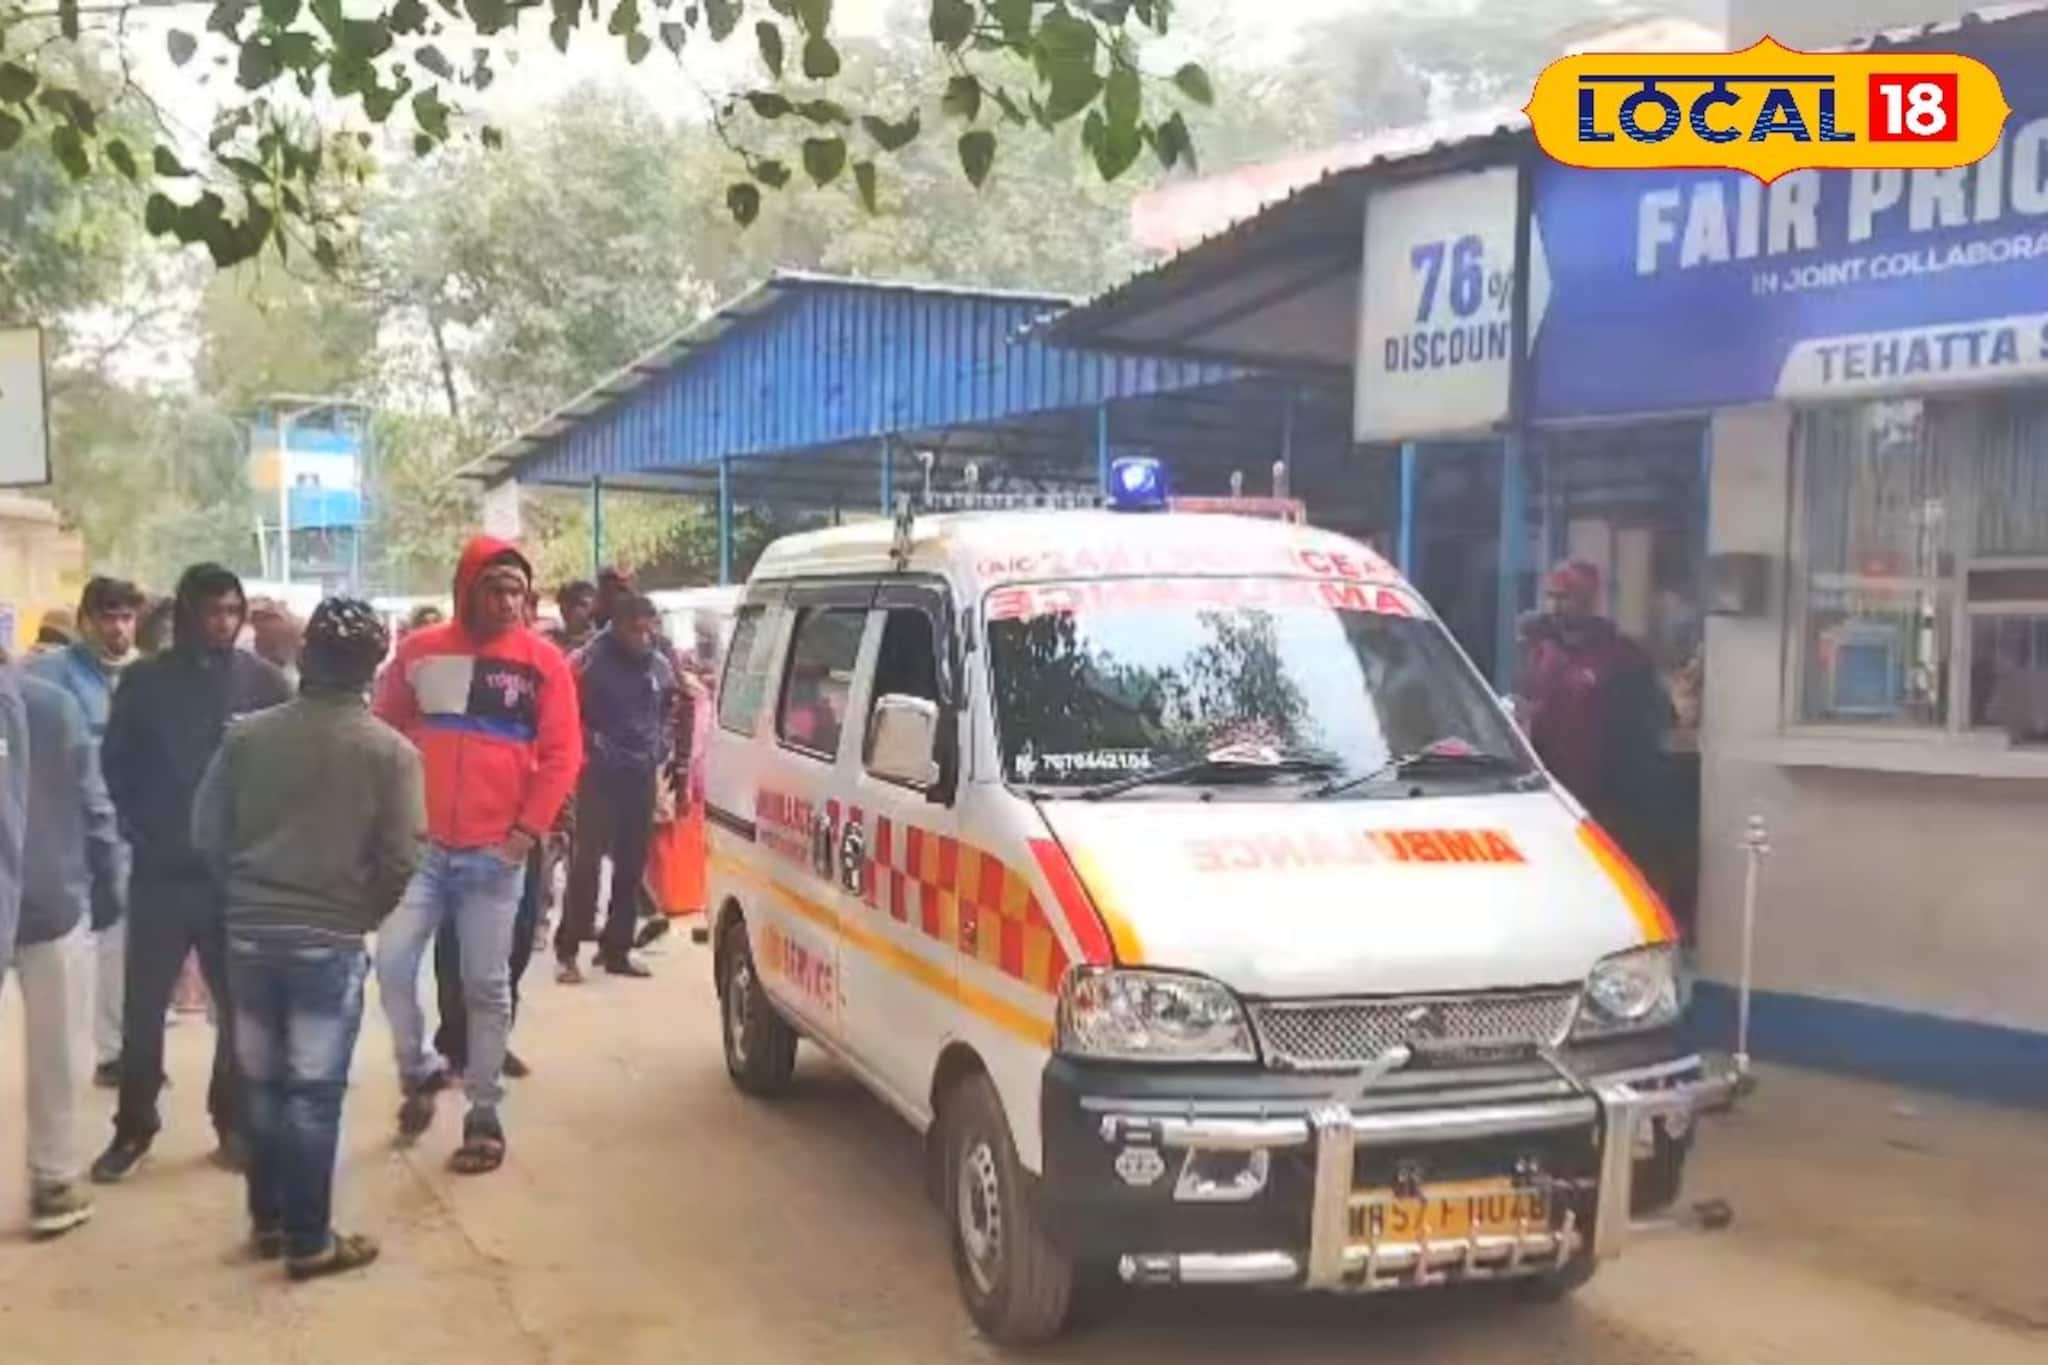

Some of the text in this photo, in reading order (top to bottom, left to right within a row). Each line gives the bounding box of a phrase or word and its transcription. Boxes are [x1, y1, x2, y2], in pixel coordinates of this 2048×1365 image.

[1636, 168, 1821, 275] FAIR
[1752, 231, 2048, 296] IN JOINT COLLABORA
[1384, 321, 1510, 373] DISCOUN
[1815, 327, 2020, 384] TEHATTA
